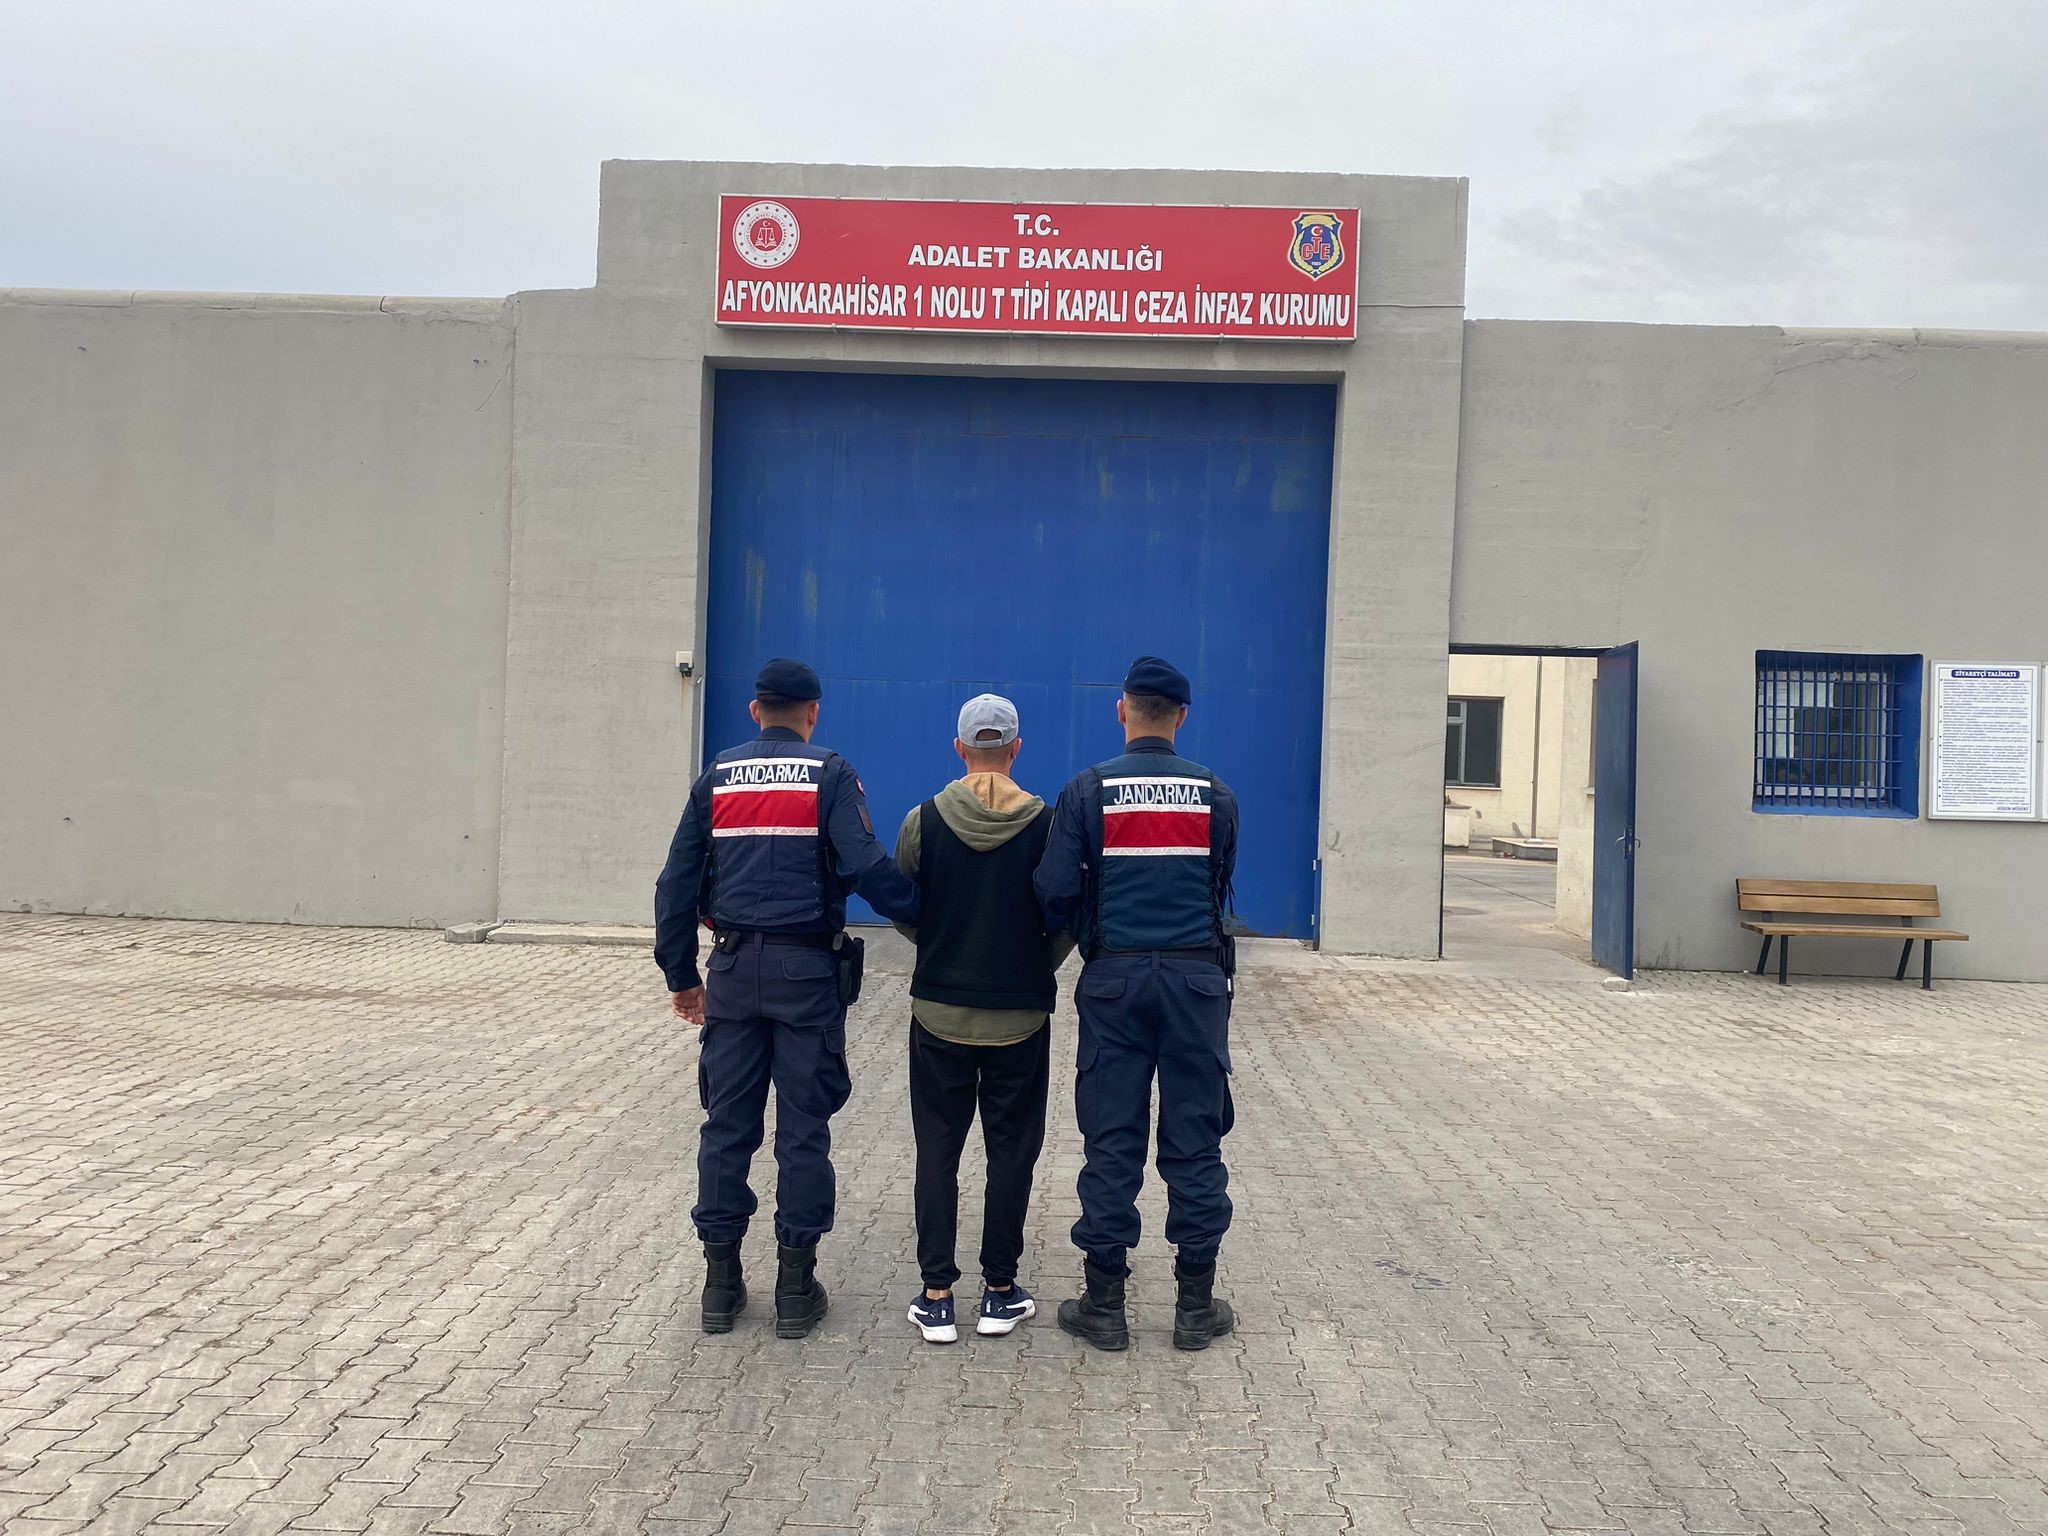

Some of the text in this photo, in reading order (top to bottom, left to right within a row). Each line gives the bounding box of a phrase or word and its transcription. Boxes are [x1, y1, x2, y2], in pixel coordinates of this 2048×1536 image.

[1013, 214, 1059, 236] T.C.
[908, 244, 1162, 272] ADALET BAKANLIĞI
[721, 276, 1350, 327] AFYONKARAHİSAR 1 NOLU T TİPİ KAPALI CEZA İNFAZ KURUMU
[725, 764, 810, 785] JANDARMA
[1113, 784, 1202, 805] JANDARMA
